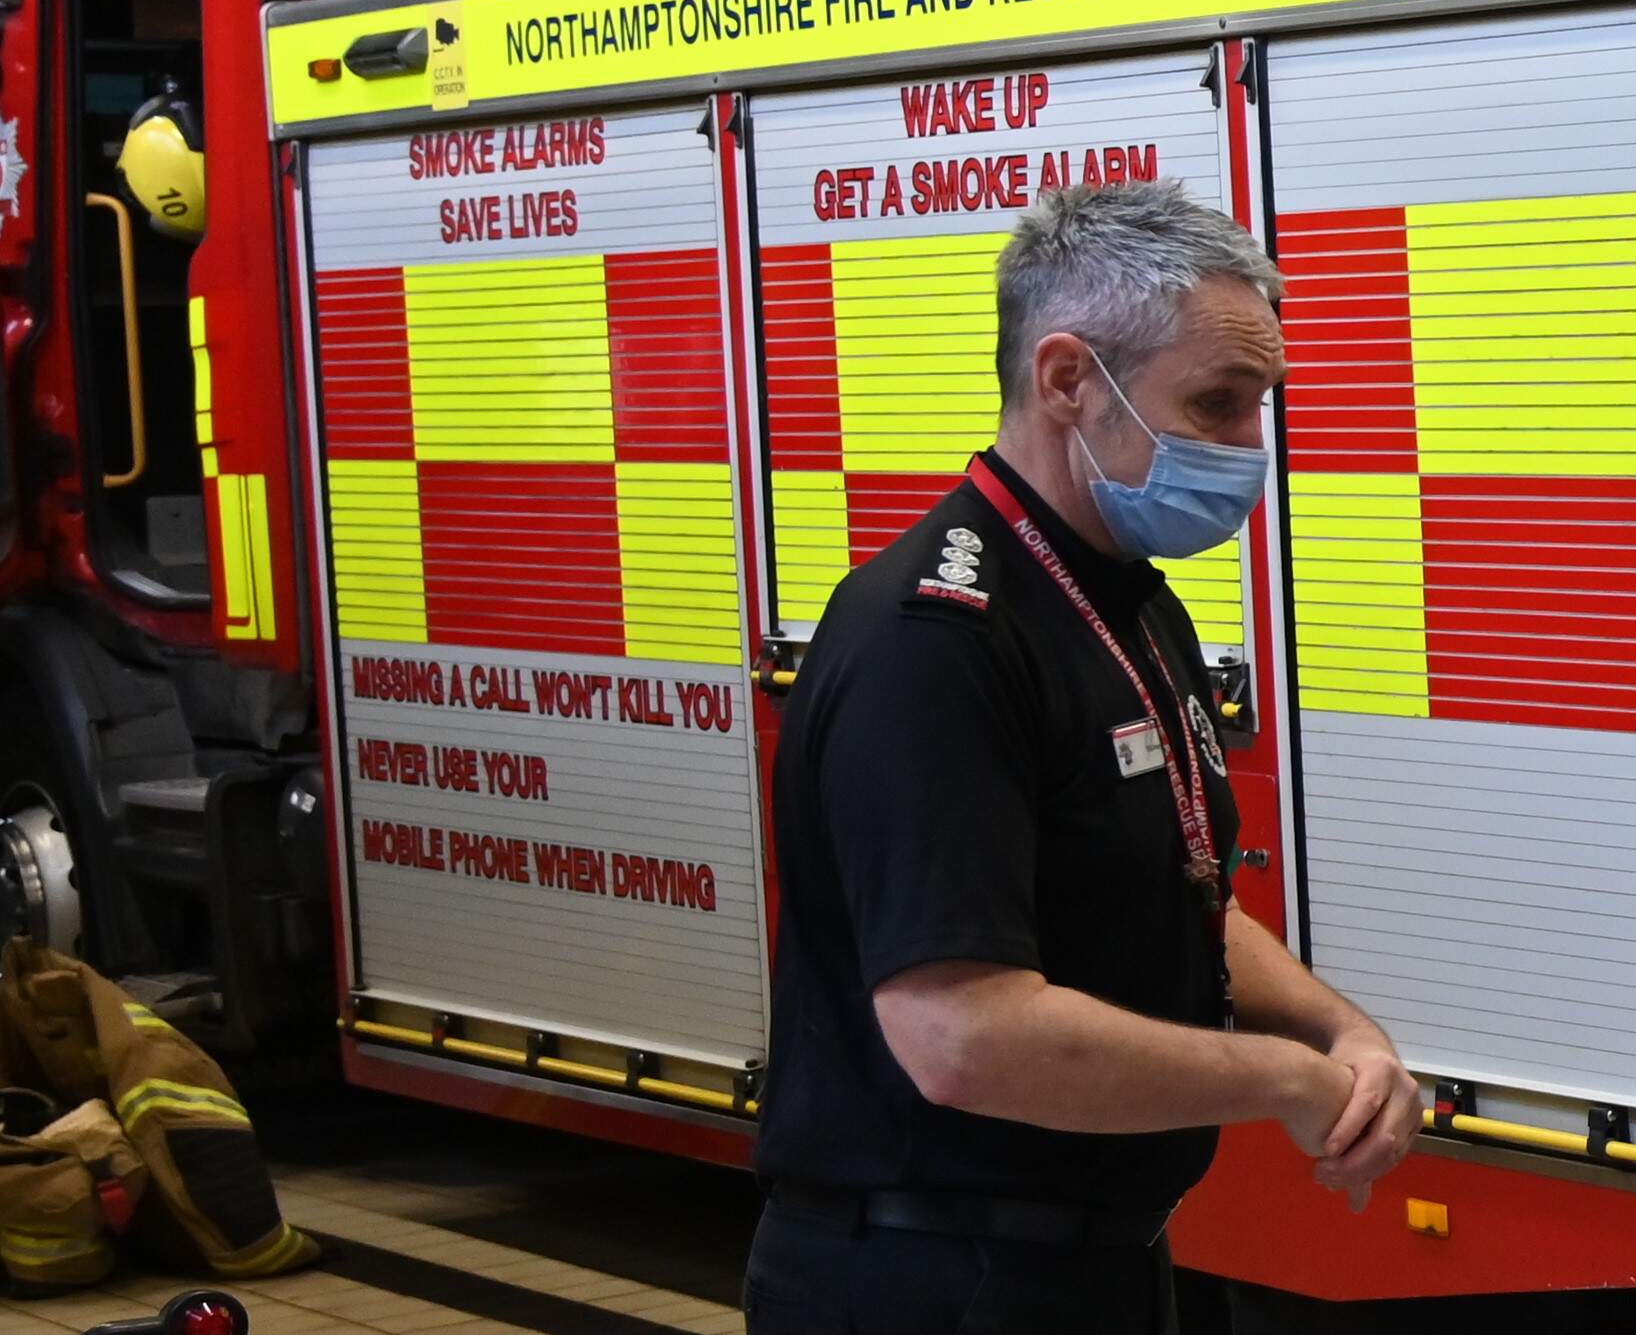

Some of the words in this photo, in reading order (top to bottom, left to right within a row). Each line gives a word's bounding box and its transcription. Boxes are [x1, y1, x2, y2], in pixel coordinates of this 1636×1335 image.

[900, 77, 996, 139] WAKE
[1003, 72, 1049, 129] UP
[409, 128, 496, 181] SMOKE
[501, 117, 606, 172] ALARMS
[156, 186, 189, 218] 10
[440, 195, 503, 244] SAVE
[508, 189, 579, 239] LIVES
[813, 166, 874, 222] GET
[880, 165, 905, 216] A
[910, 154, 1029, 215] SMOKE
[1014, 517, 1145, 693] NORTHAMPTONSHIRE
[351, 655, 445, 706] MISSING
[450, 664, 467, 708] A
[469, 665, 531, 714] CALL
[532, 669, 612, 721] WON'T
[617, 676, 674, 726] KILL
[675, 682, 733, 733] YOU
[357, 737, 430, 787] NEVER
[432, 746, 480, 793] USE
[481, 750, 549, 801] YOUR
[1167, 759, 1197, 836] RESCUE
[362, 818, 447, 872] MOBILE
[449, 829, 533, 885] PHONE
[532, 841, 607, 896] WHEN
[611, 851, 717, 913] DRIVING
